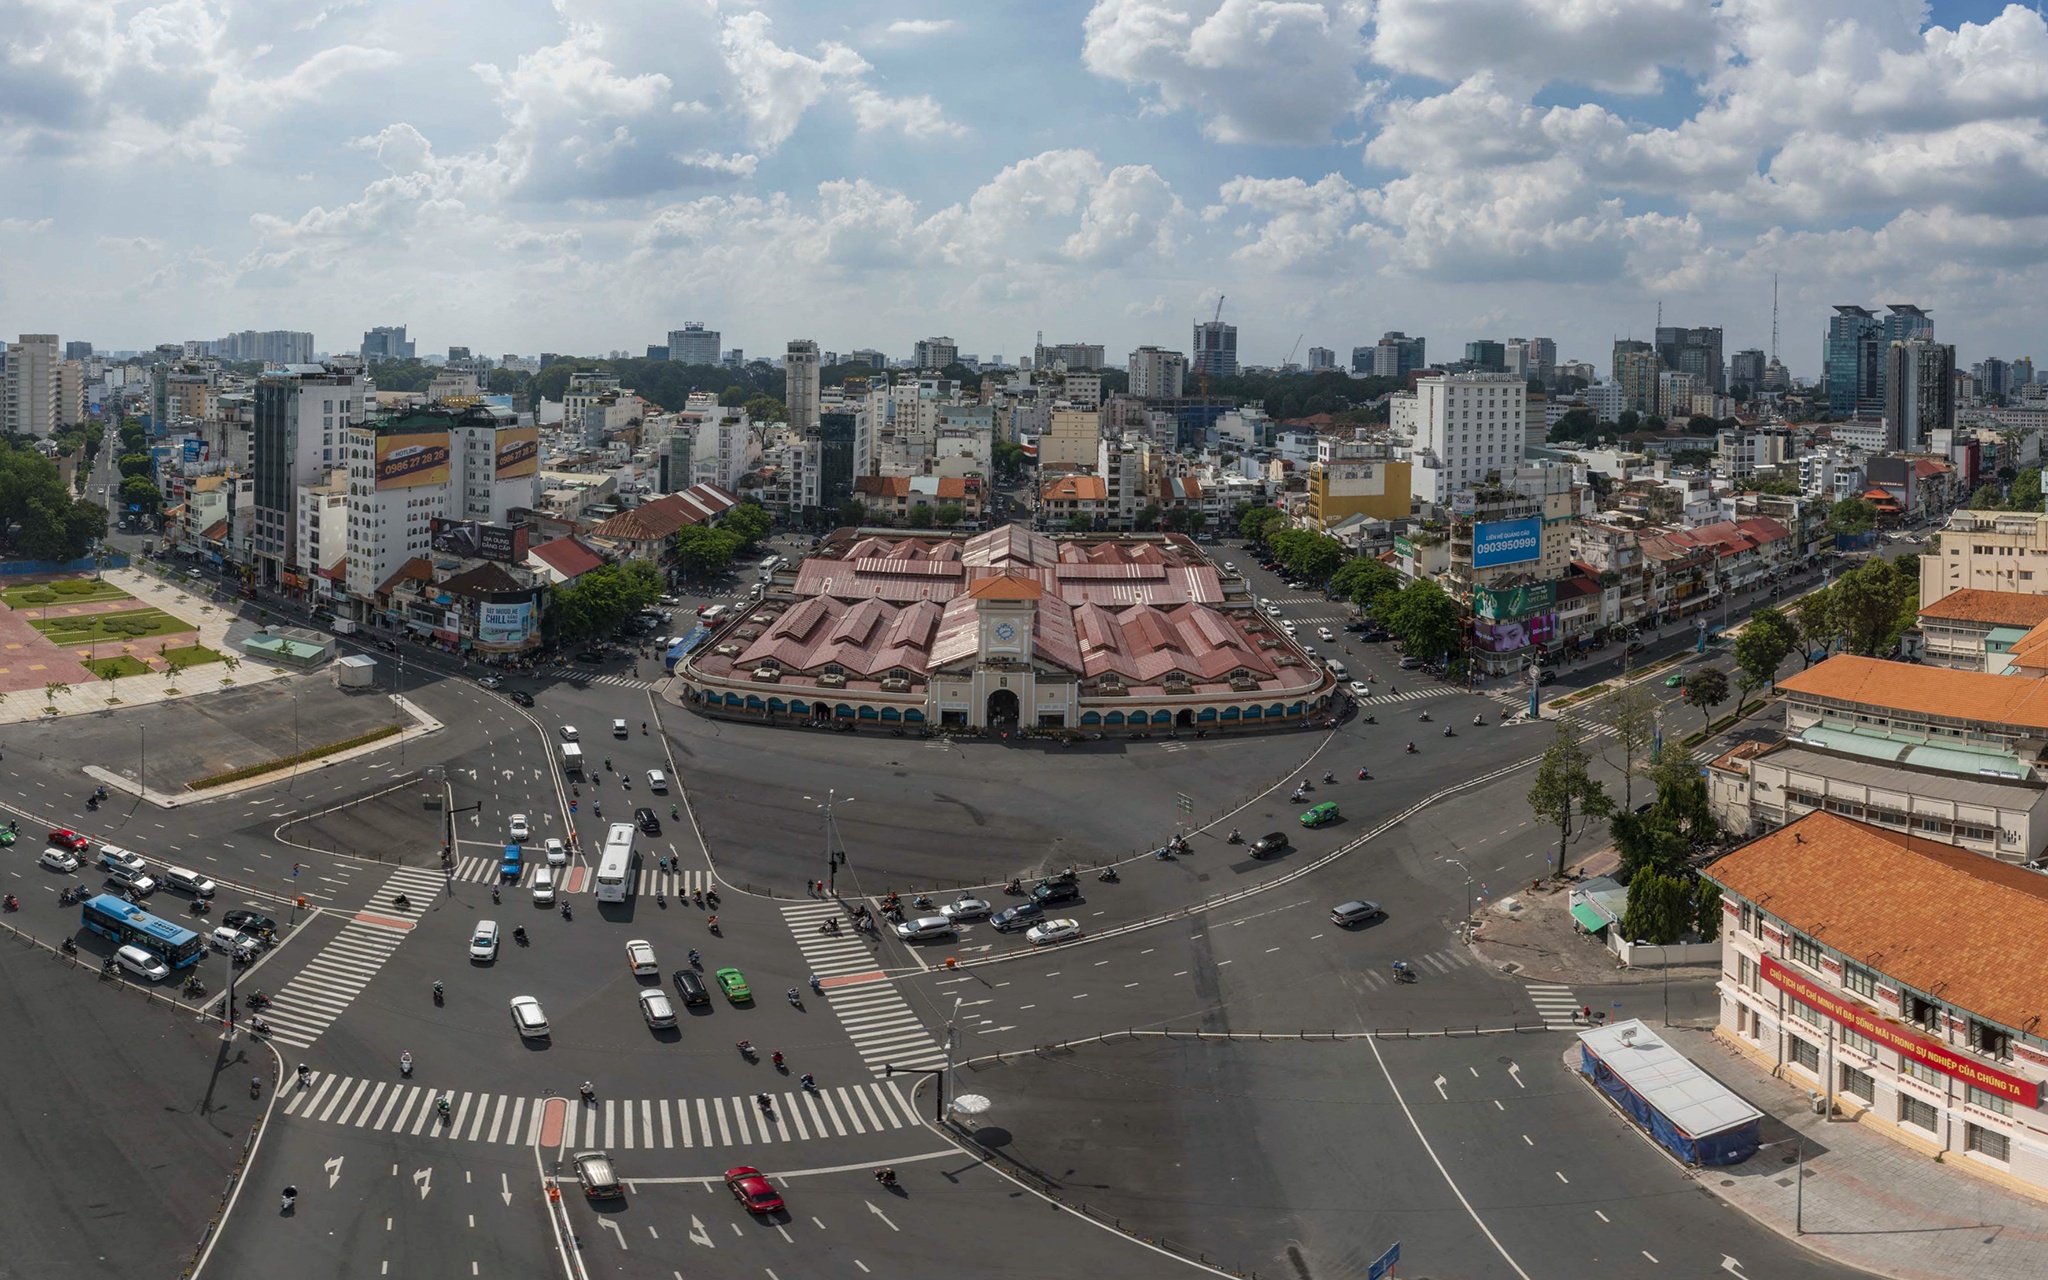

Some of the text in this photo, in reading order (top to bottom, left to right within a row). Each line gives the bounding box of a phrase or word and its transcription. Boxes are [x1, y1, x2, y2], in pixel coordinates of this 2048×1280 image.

[395, 447, 418, 457] HOTLINE
[500, 453, 514, 466] 0986
[514, 450, 522, 460] 27
[522, 447, 529, 457] 28
[385, 450, 445, 475] 0986 27 28 28
[1477, 537, 1536, 554] 0903950999
[486, 613, 507, 624] CHILL
[1769, 968, 1781, 981] CHỦ
[1782, 975, 1796, 987] TỊCH
[1796, 983, 1806, 995] HỒ
[1806, 989, 1817, 1002] CHÍ
[1817, 996, 1835, 1011] MINH
[1835, 1004, 1843, 1016] VĨ
[1855, 1015, 1875, 1032] SỐNG
[1875, 1026, 1889, 1040] MÃI
[1890, 1033, 1915, 1052] TRONG
[1916, 1046, 1927, 1059] SỰ
[1928, 1051, 1957, 1070] NGHIỆP
[1958, 1064, 1976, 1079] CỦA
[1977, 1071, 2007, 1090] CHÚNG
[2008, 1083, 2020, 1096] TA
